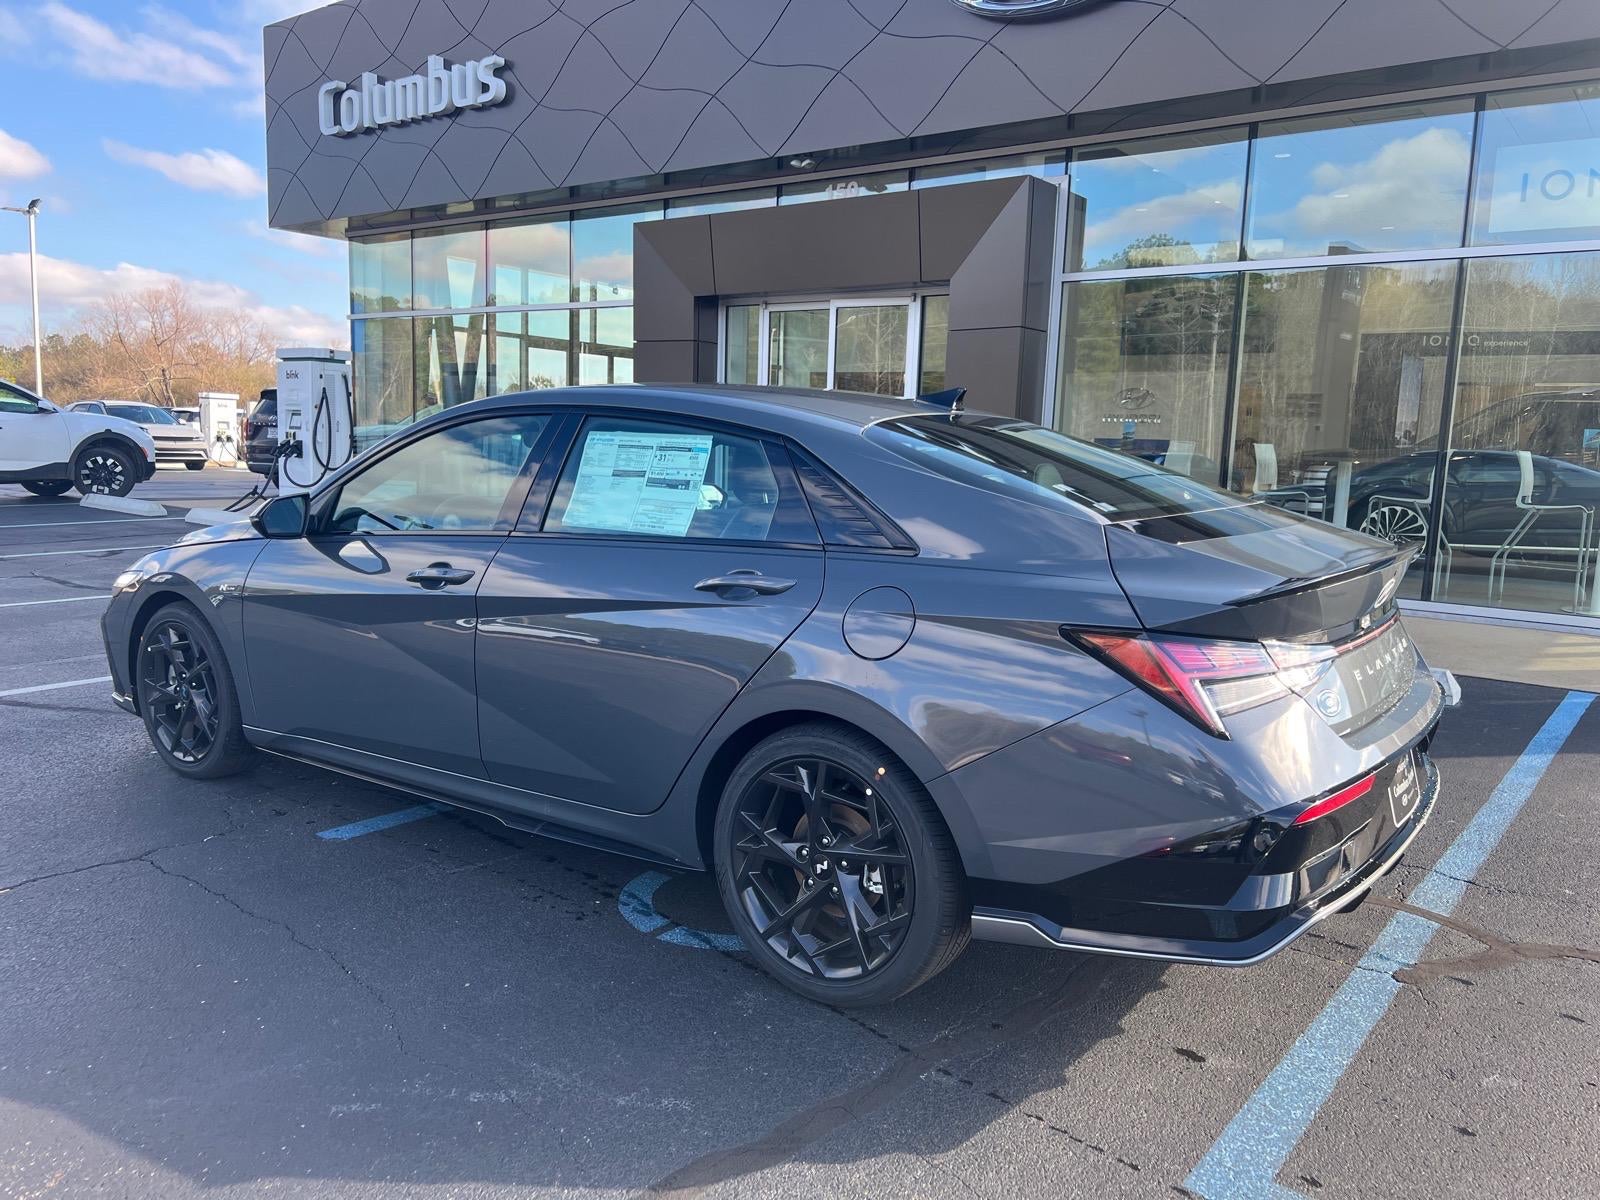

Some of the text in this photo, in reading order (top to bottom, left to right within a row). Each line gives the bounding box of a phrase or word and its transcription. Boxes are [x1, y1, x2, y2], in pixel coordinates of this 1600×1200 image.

[318, 54, 507, 136] Columbus
[825, 181, 860, 200] 150
[1483, 338, 1529, 348] experience
